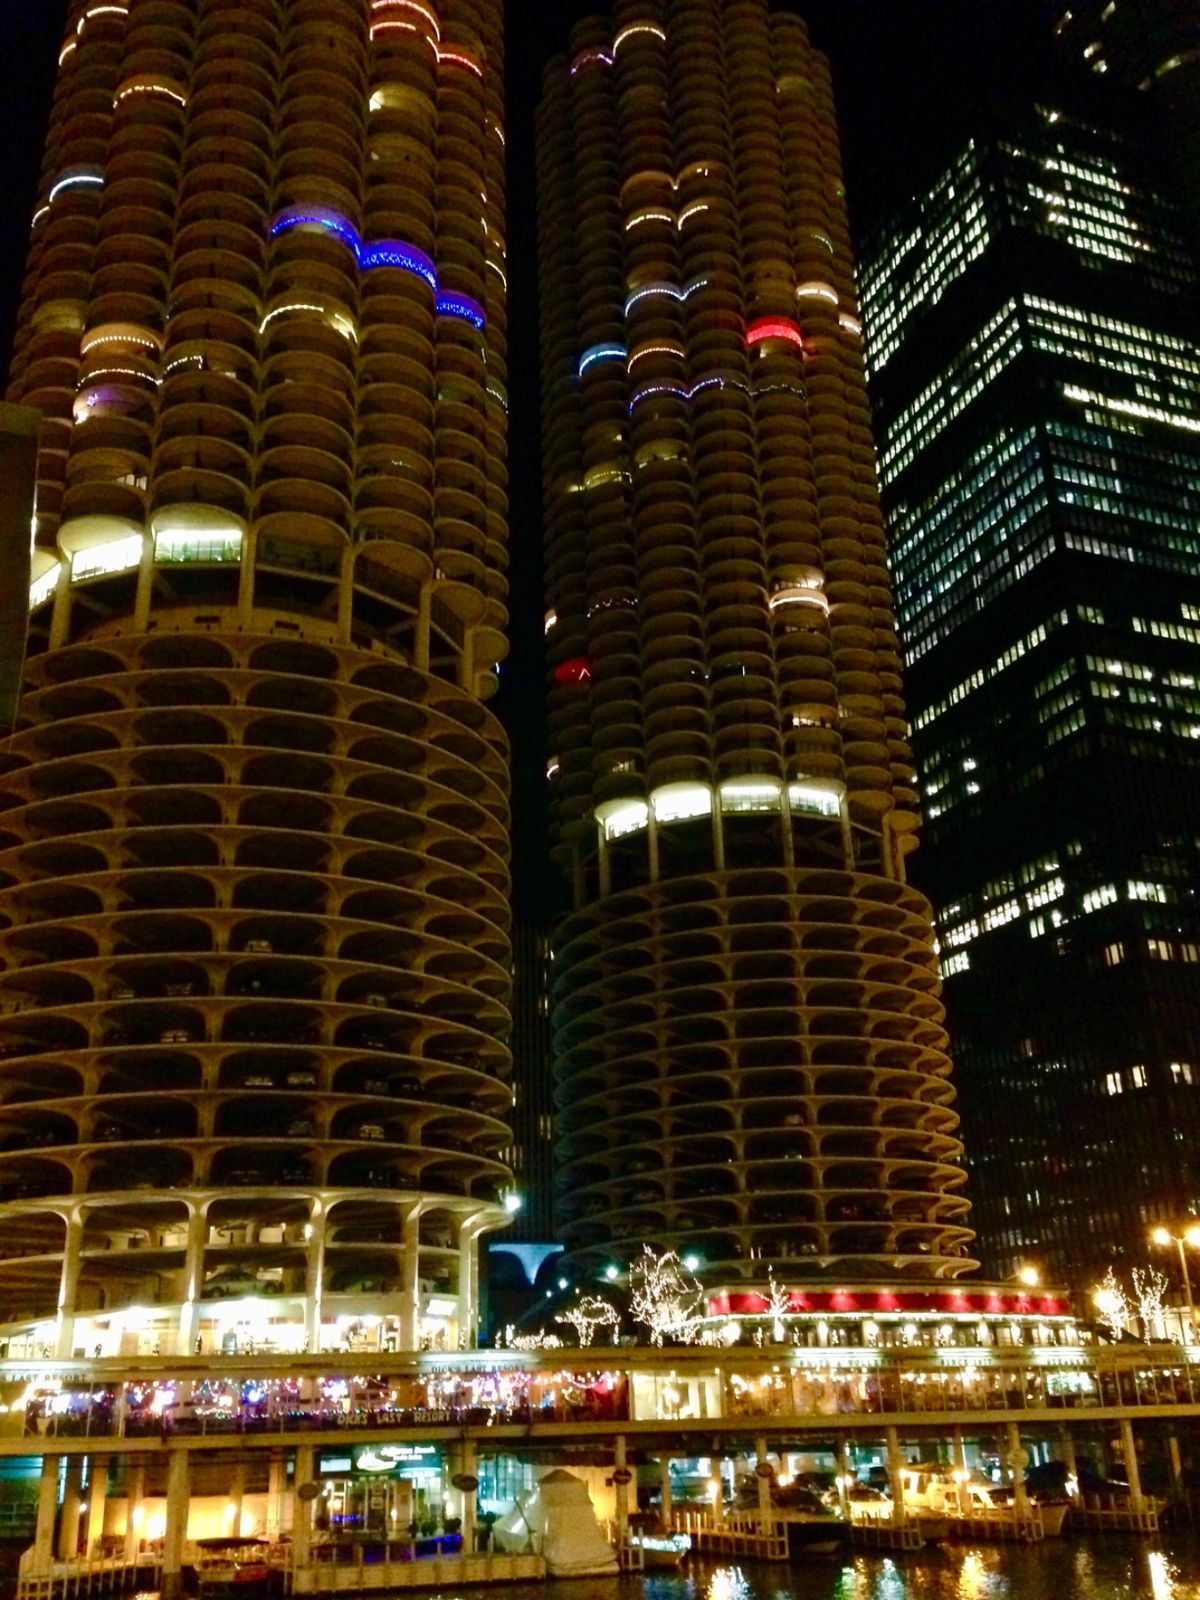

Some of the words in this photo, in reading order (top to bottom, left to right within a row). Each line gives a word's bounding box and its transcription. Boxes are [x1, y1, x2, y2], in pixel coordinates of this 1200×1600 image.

[465, 1365, 487, 1373] LAST
[491, 1364, 525, 1373] RESORT
[12, 1373, 39, 1382] LAST
[44, 1373, 88, 1383] RESORT
[376, 1412, 402, 1425] LAST
